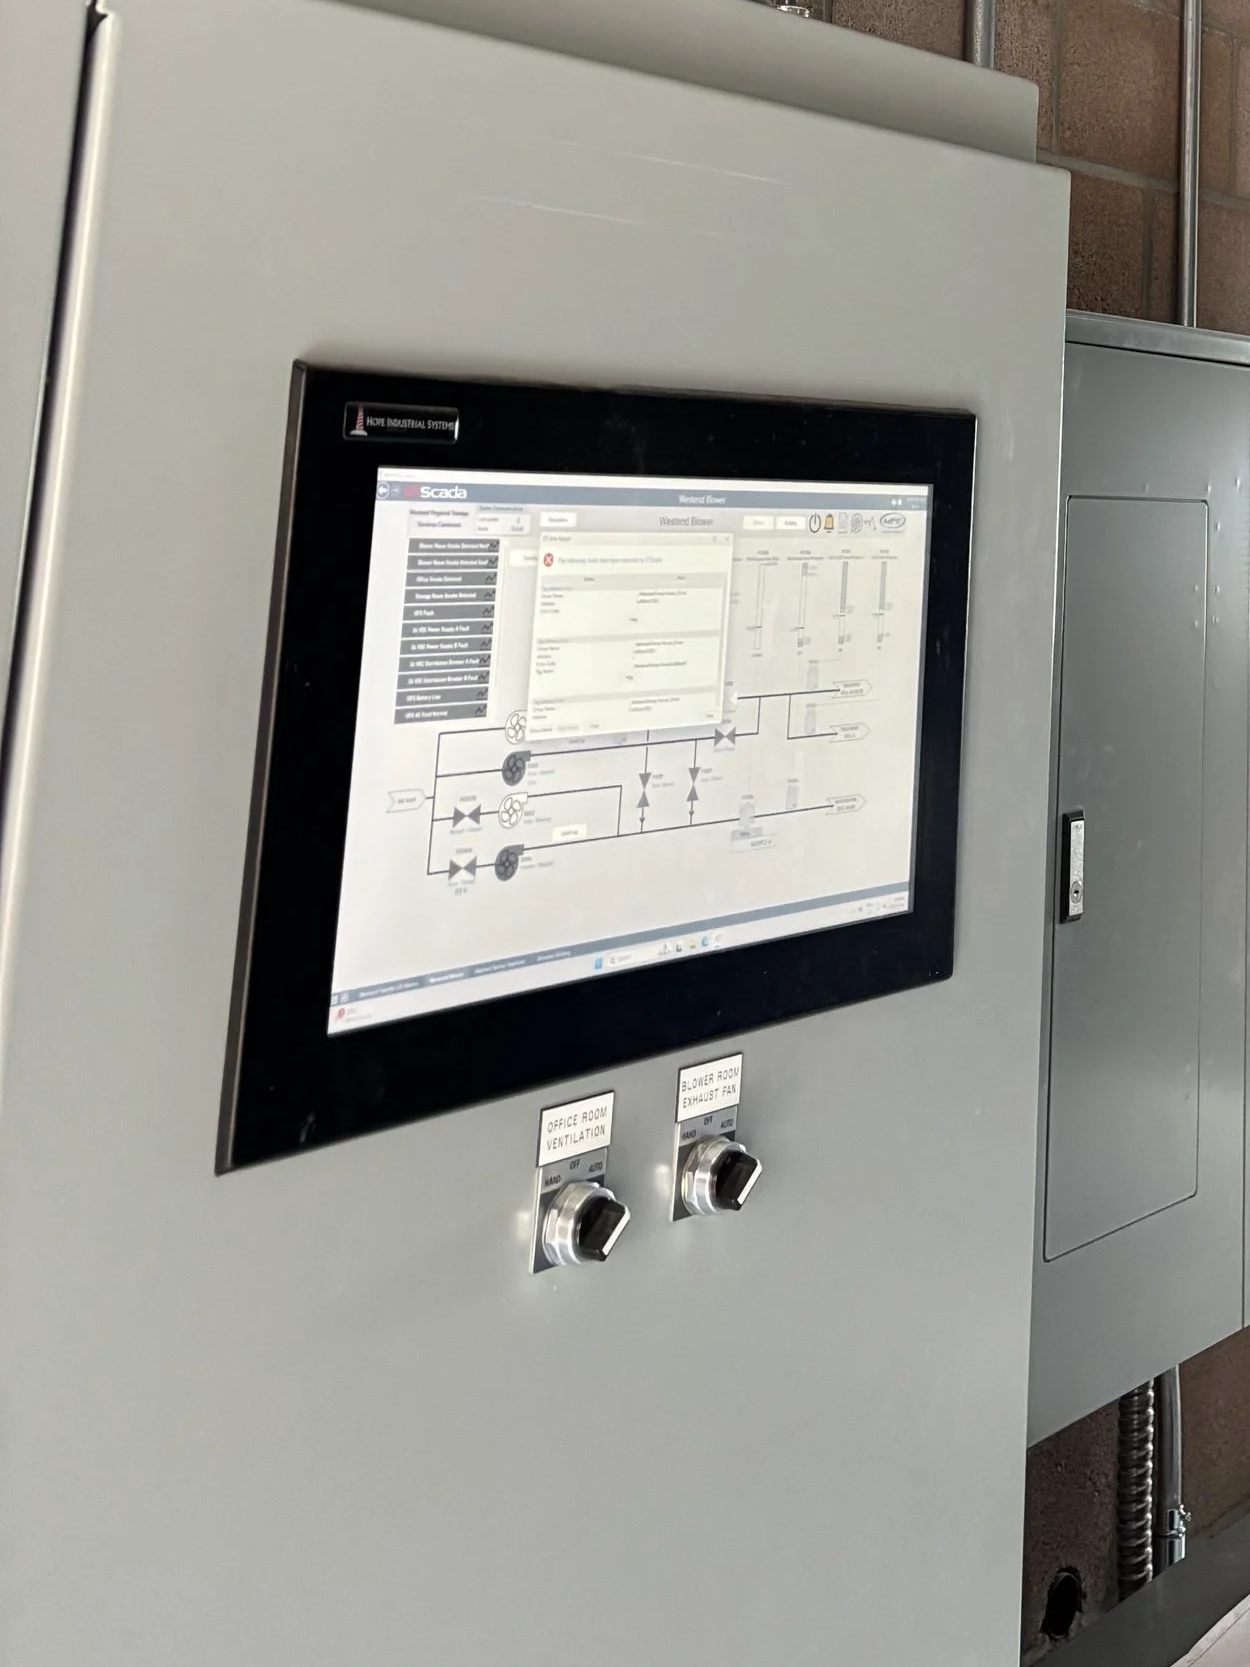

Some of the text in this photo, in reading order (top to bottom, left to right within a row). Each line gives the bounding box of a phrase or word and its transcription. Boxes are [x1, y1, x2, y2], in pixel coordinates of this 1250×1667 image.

[367, 417, 386, 427] HOPE
[387, 418, 426, 429] INDUSTRIAL
[706, 495, 726, 504] Blower
[659, 517, 713, 526] Westend Blower
[682, 1066, 739, 1092] BLOWER ROOM
[682, 1084, 736, 1109] EXHAUST FAN
[547, 1107, 607, 1133] OFFICE ROOM
[703, 1115, 713, 1126] OFF
[720, 1118, 734, 1129] AUTO
[547, 1128, 606, 1151] VENTILATION
[682, 1130, 697, 1141] HAND
[569, 1158, 580, 1170] OFF
[588, 1162, 603, 1173] AUTO
[544, 1175, 561, 1187] HAND
